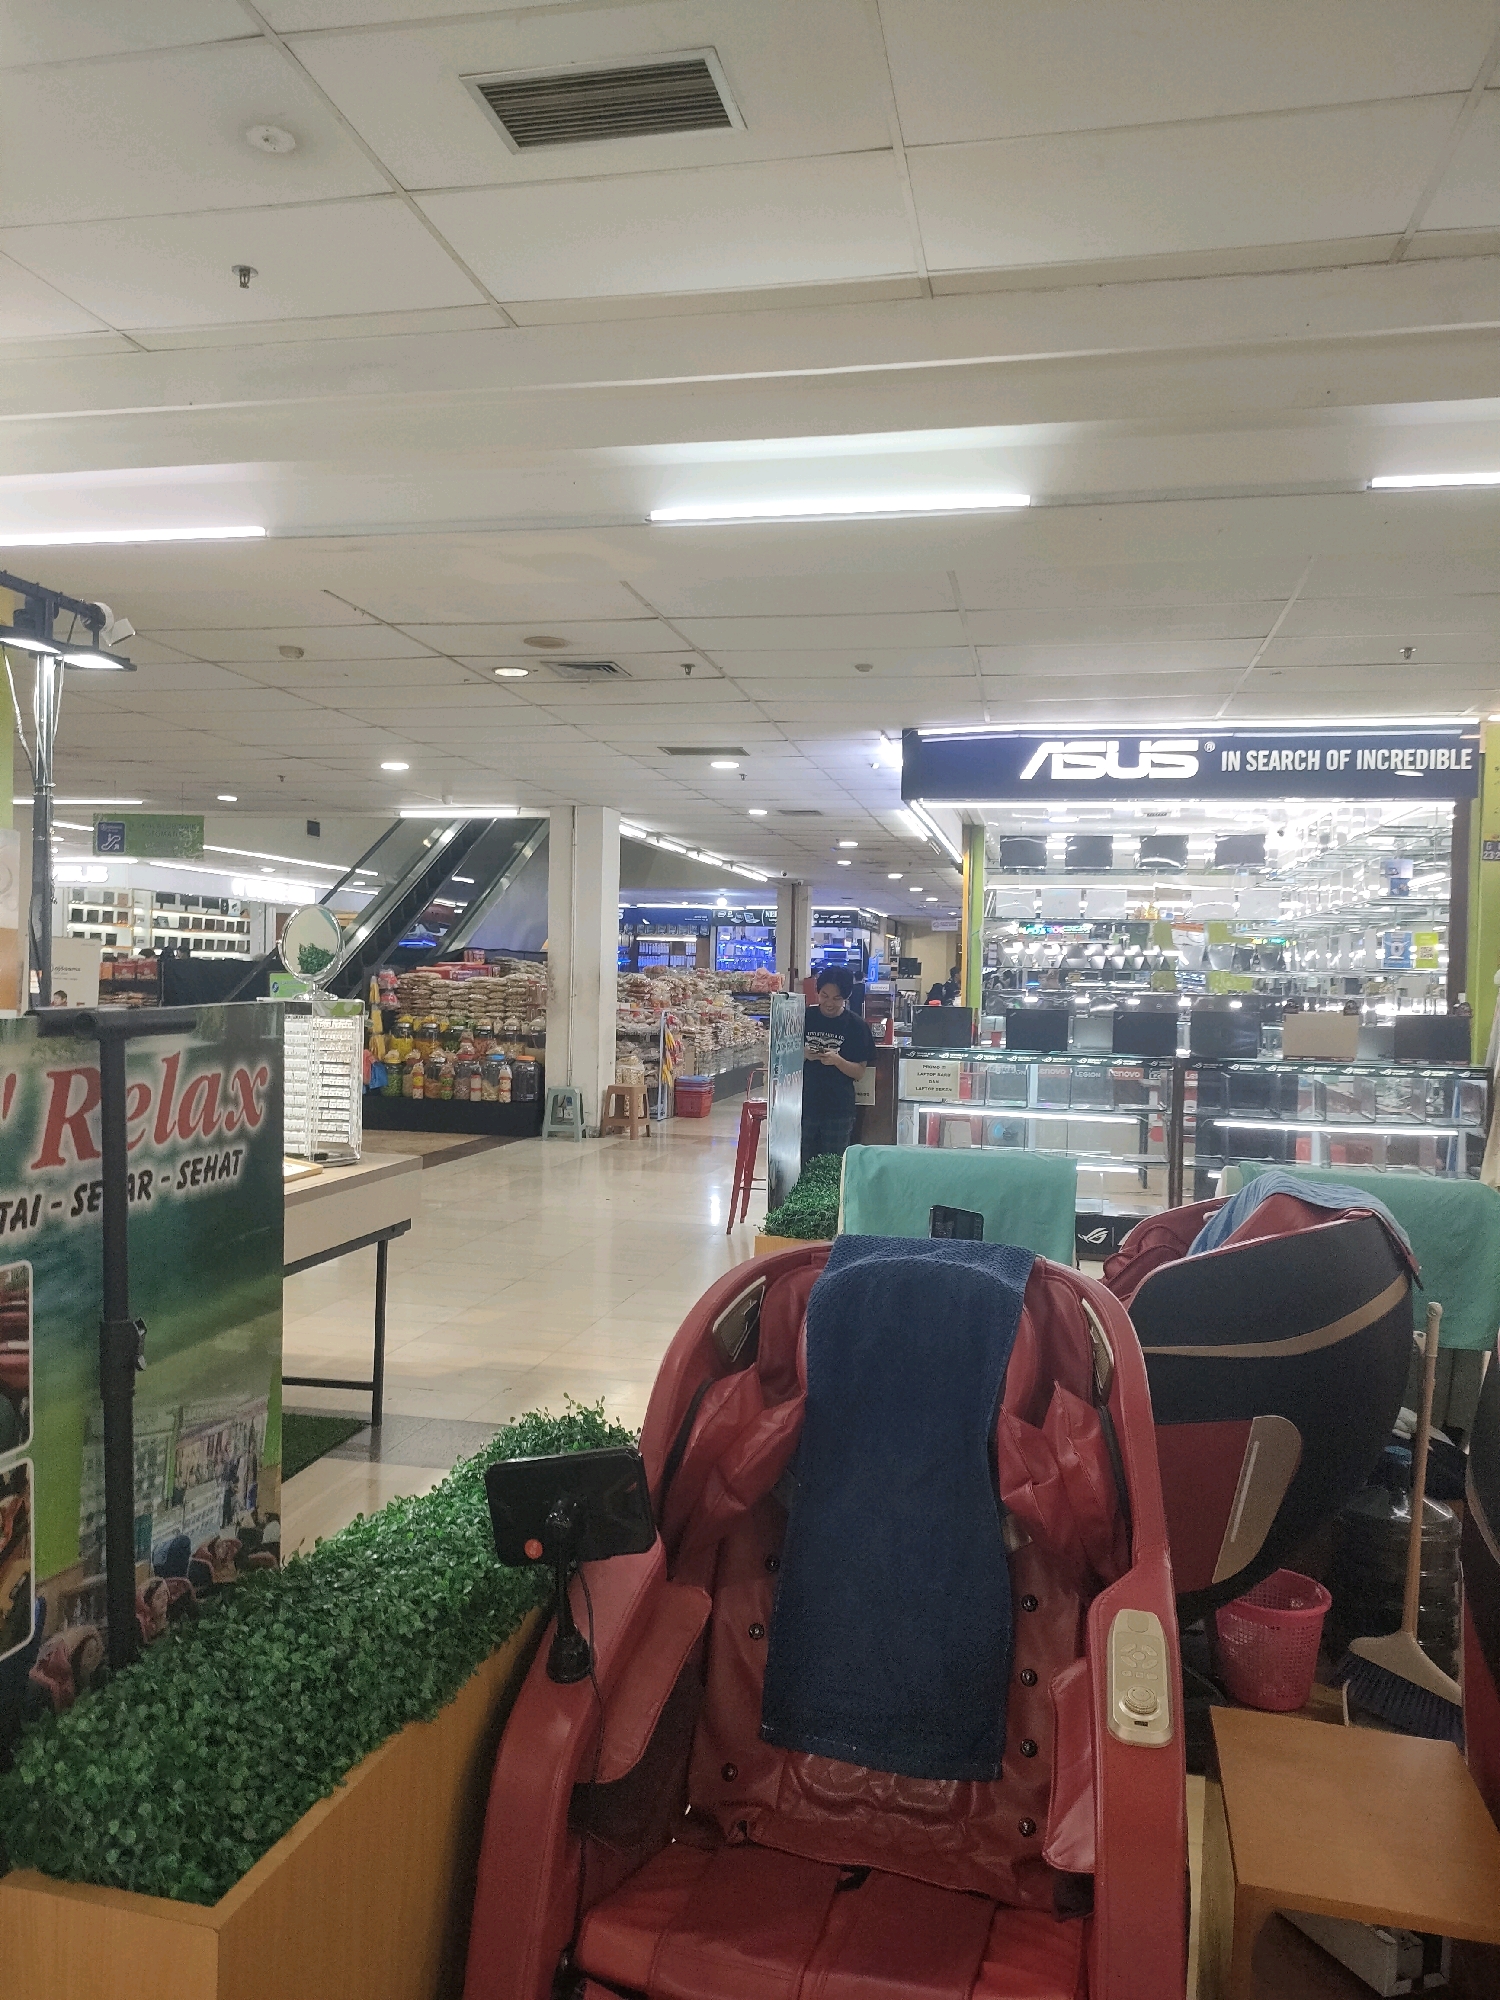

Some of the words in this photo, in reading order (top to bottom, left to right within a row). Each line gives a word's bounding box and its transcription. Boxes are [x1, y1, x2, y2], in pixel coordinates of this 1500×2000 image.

[1020, 739, 1199, 780] ASUS
[1221, 751, 1240, 771] IN
[1246, 750, 1319, 771] SEARCH
[1326, 750, 1351, 770] OF
[1356, 748, 1472, 770] INCREDIBLE
[31, 1051, 268, 1170] Relax
[71, 1169, 153, 1218] SEAR
[176, 1149, 243, 1190] SEHAT
